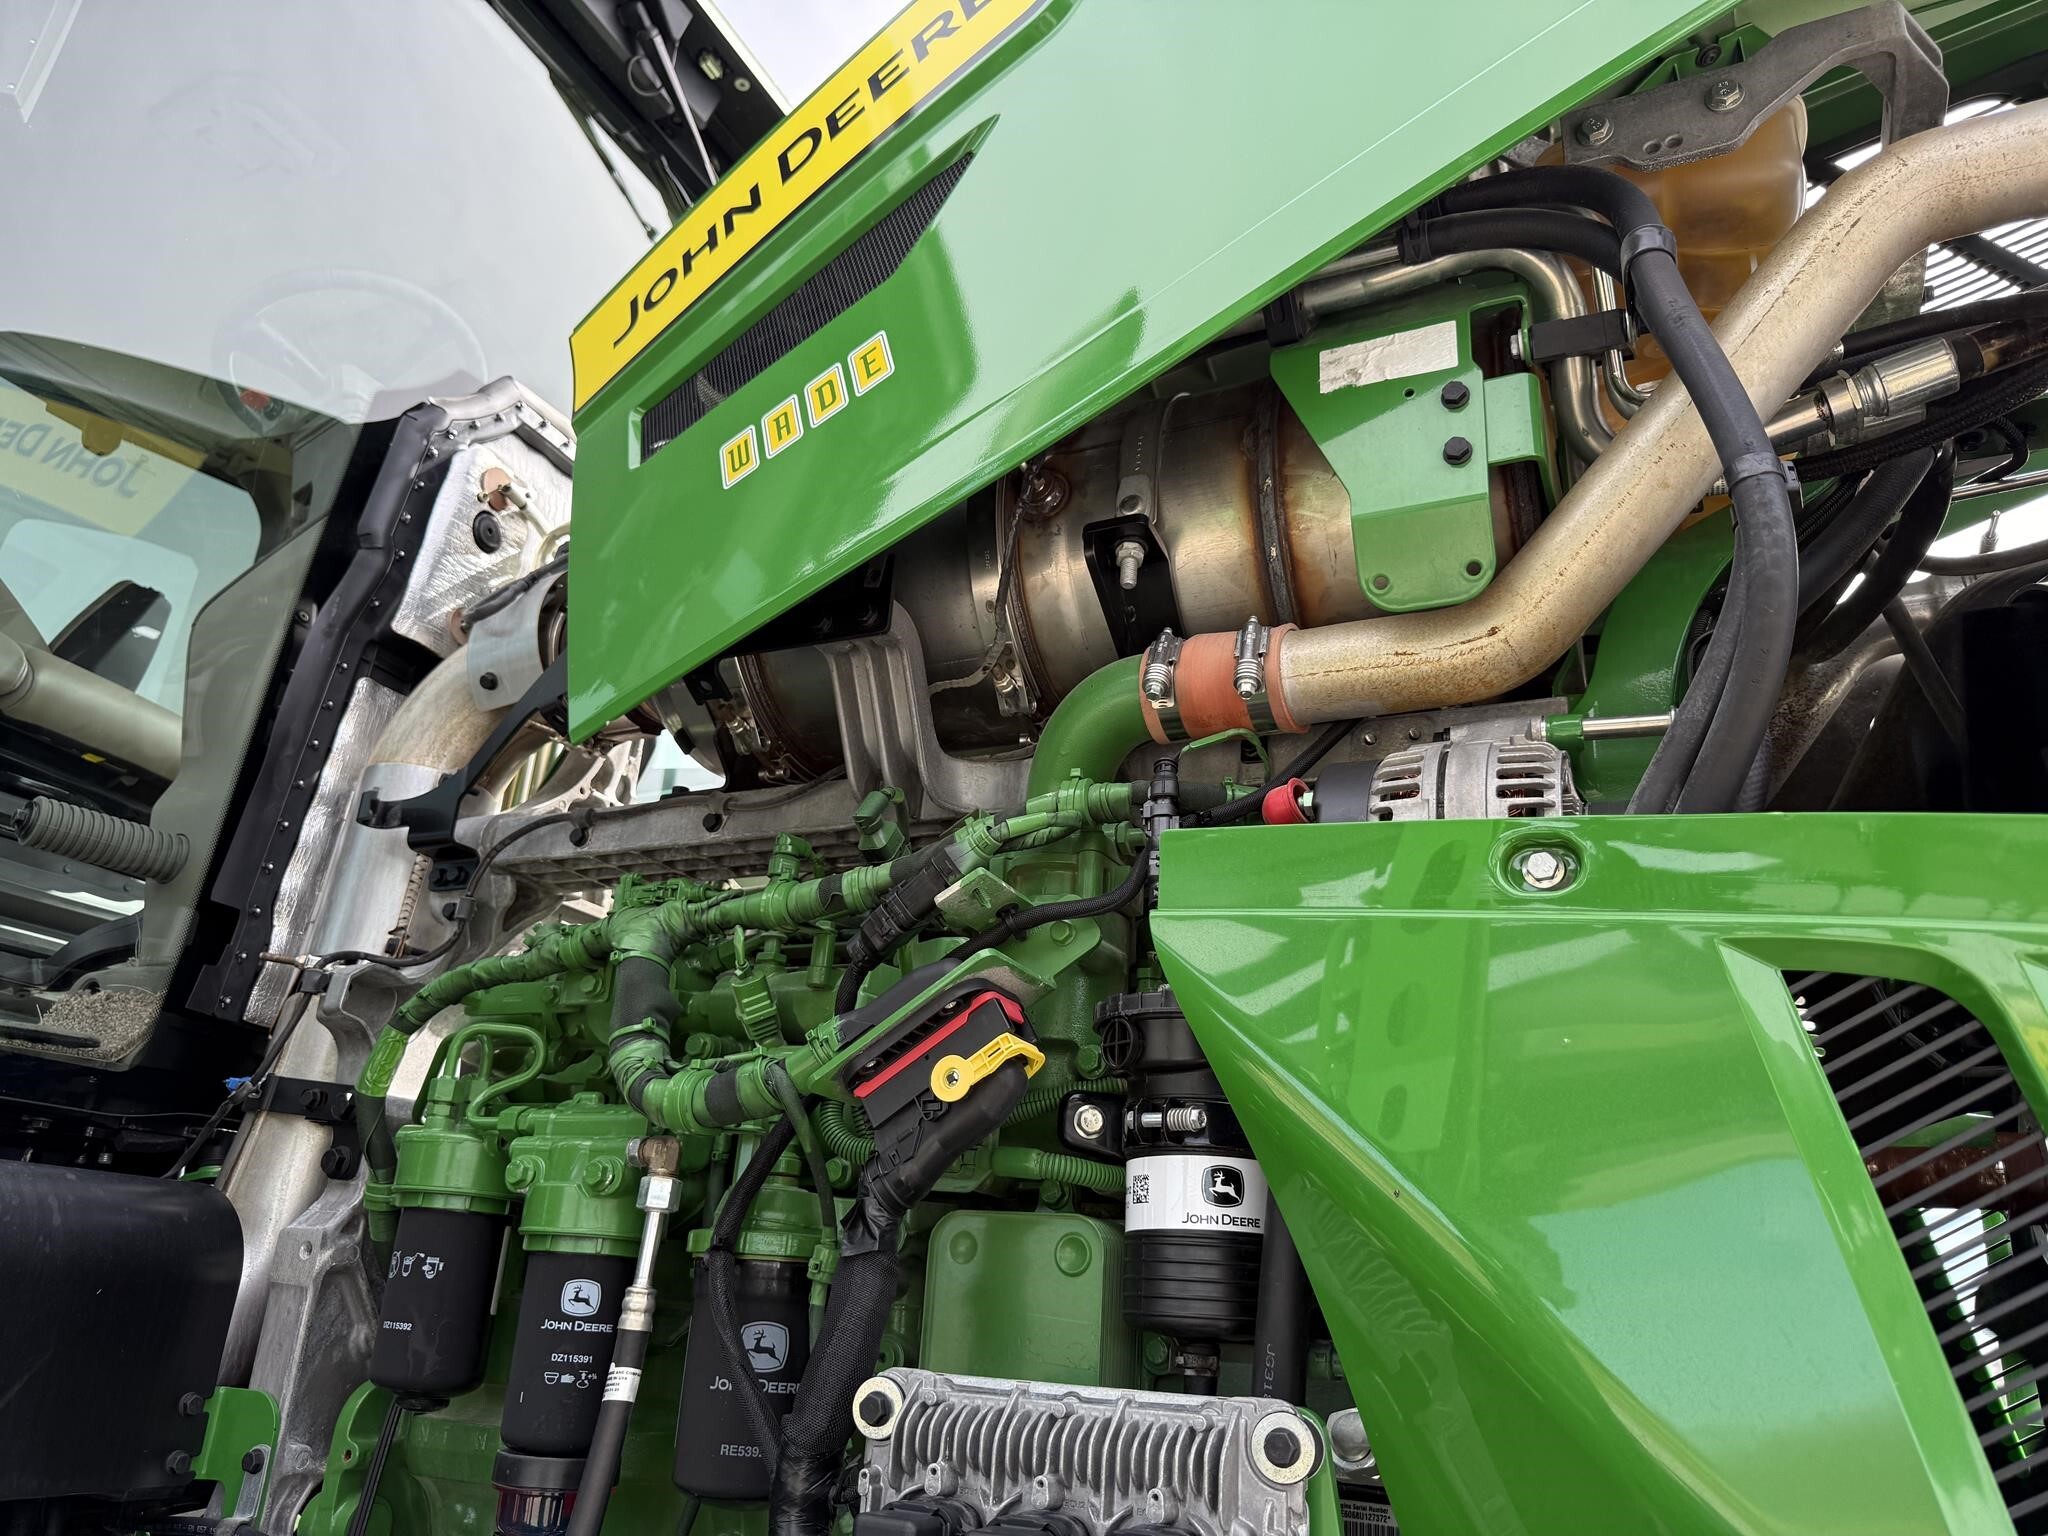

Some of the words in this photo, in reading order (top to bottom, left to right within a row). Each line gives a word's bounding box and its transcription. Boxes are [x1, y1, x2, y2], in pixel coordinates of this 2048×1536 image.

[613, 182, 762, 349] JOHN
[728, 346, 882, 473] WADE
[1181, 1212, 1219, 1225] JOHN
[1221, 1214, 1261, 1228] DEERE
[540, 1318, 572, 1331] JOHN
[574, 1320, 614, 1332] DEERE
[551, 1353, 593, 1363] DZ115391
[720, 1444, 762, 1457] RE539
